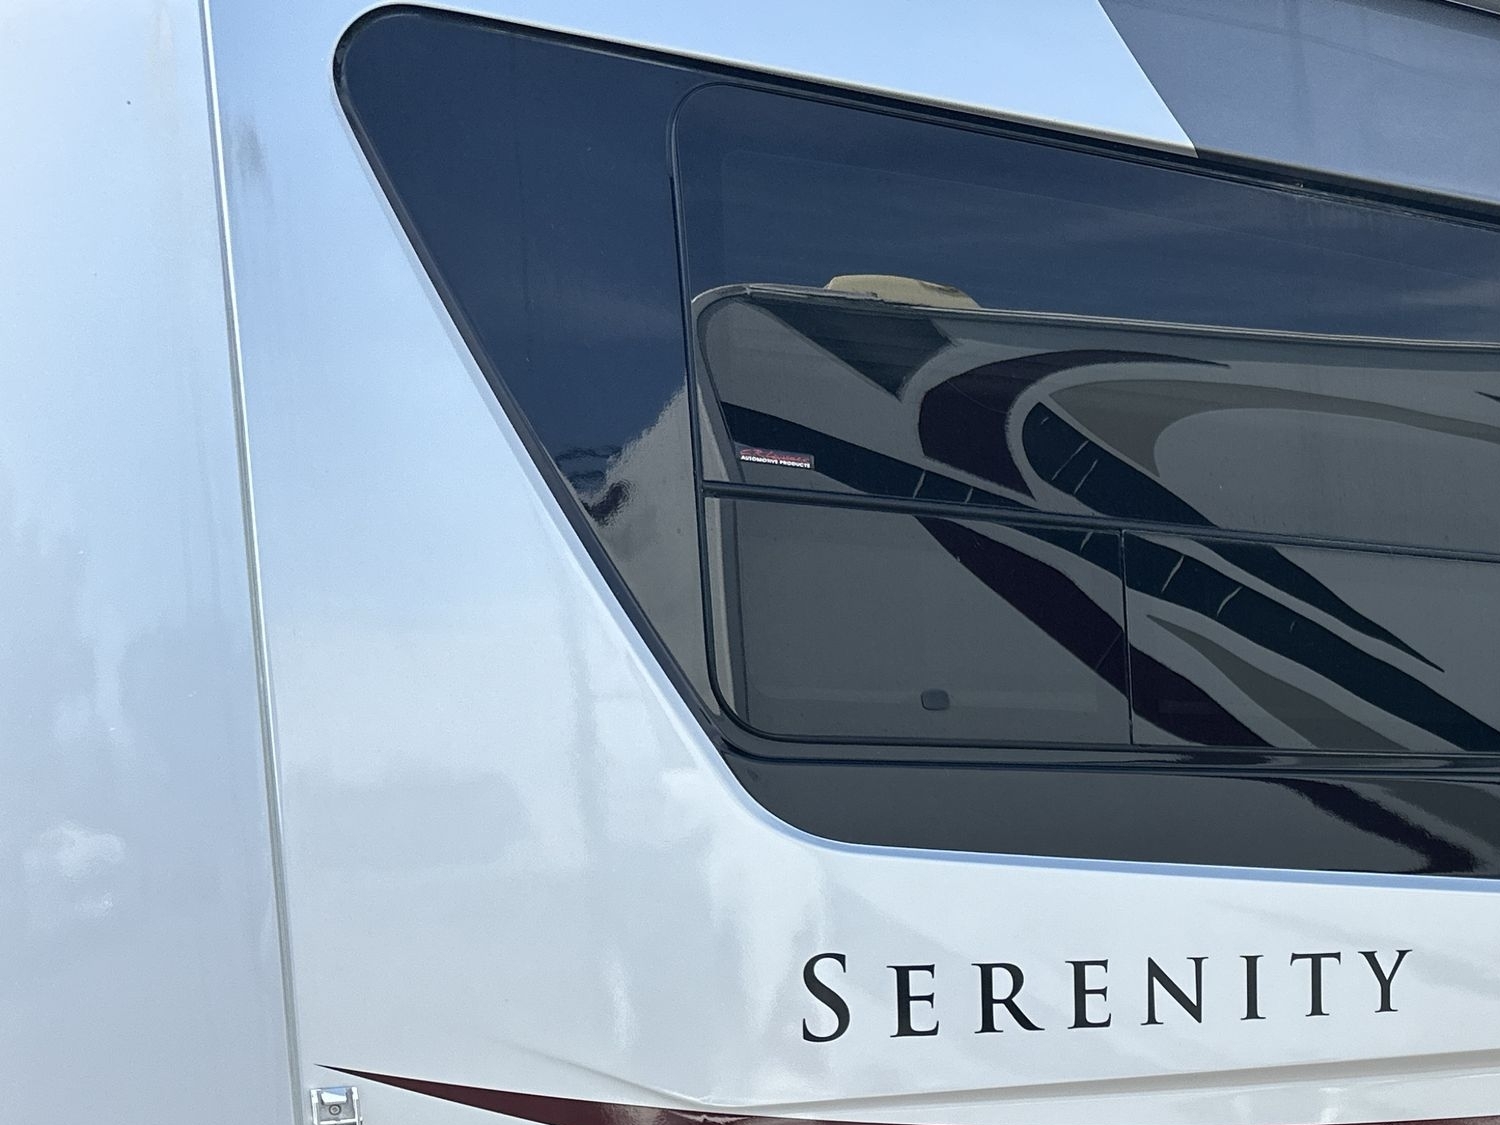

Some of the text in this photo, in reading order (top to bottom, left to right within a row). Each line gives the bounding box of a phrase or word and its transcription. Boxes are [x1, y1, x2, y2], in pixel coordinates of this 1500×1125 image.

[740, 455, 811, 468] AUTOMOTIVE PRODUCTS
[802, 949, 1413, 1043] SERENITY
